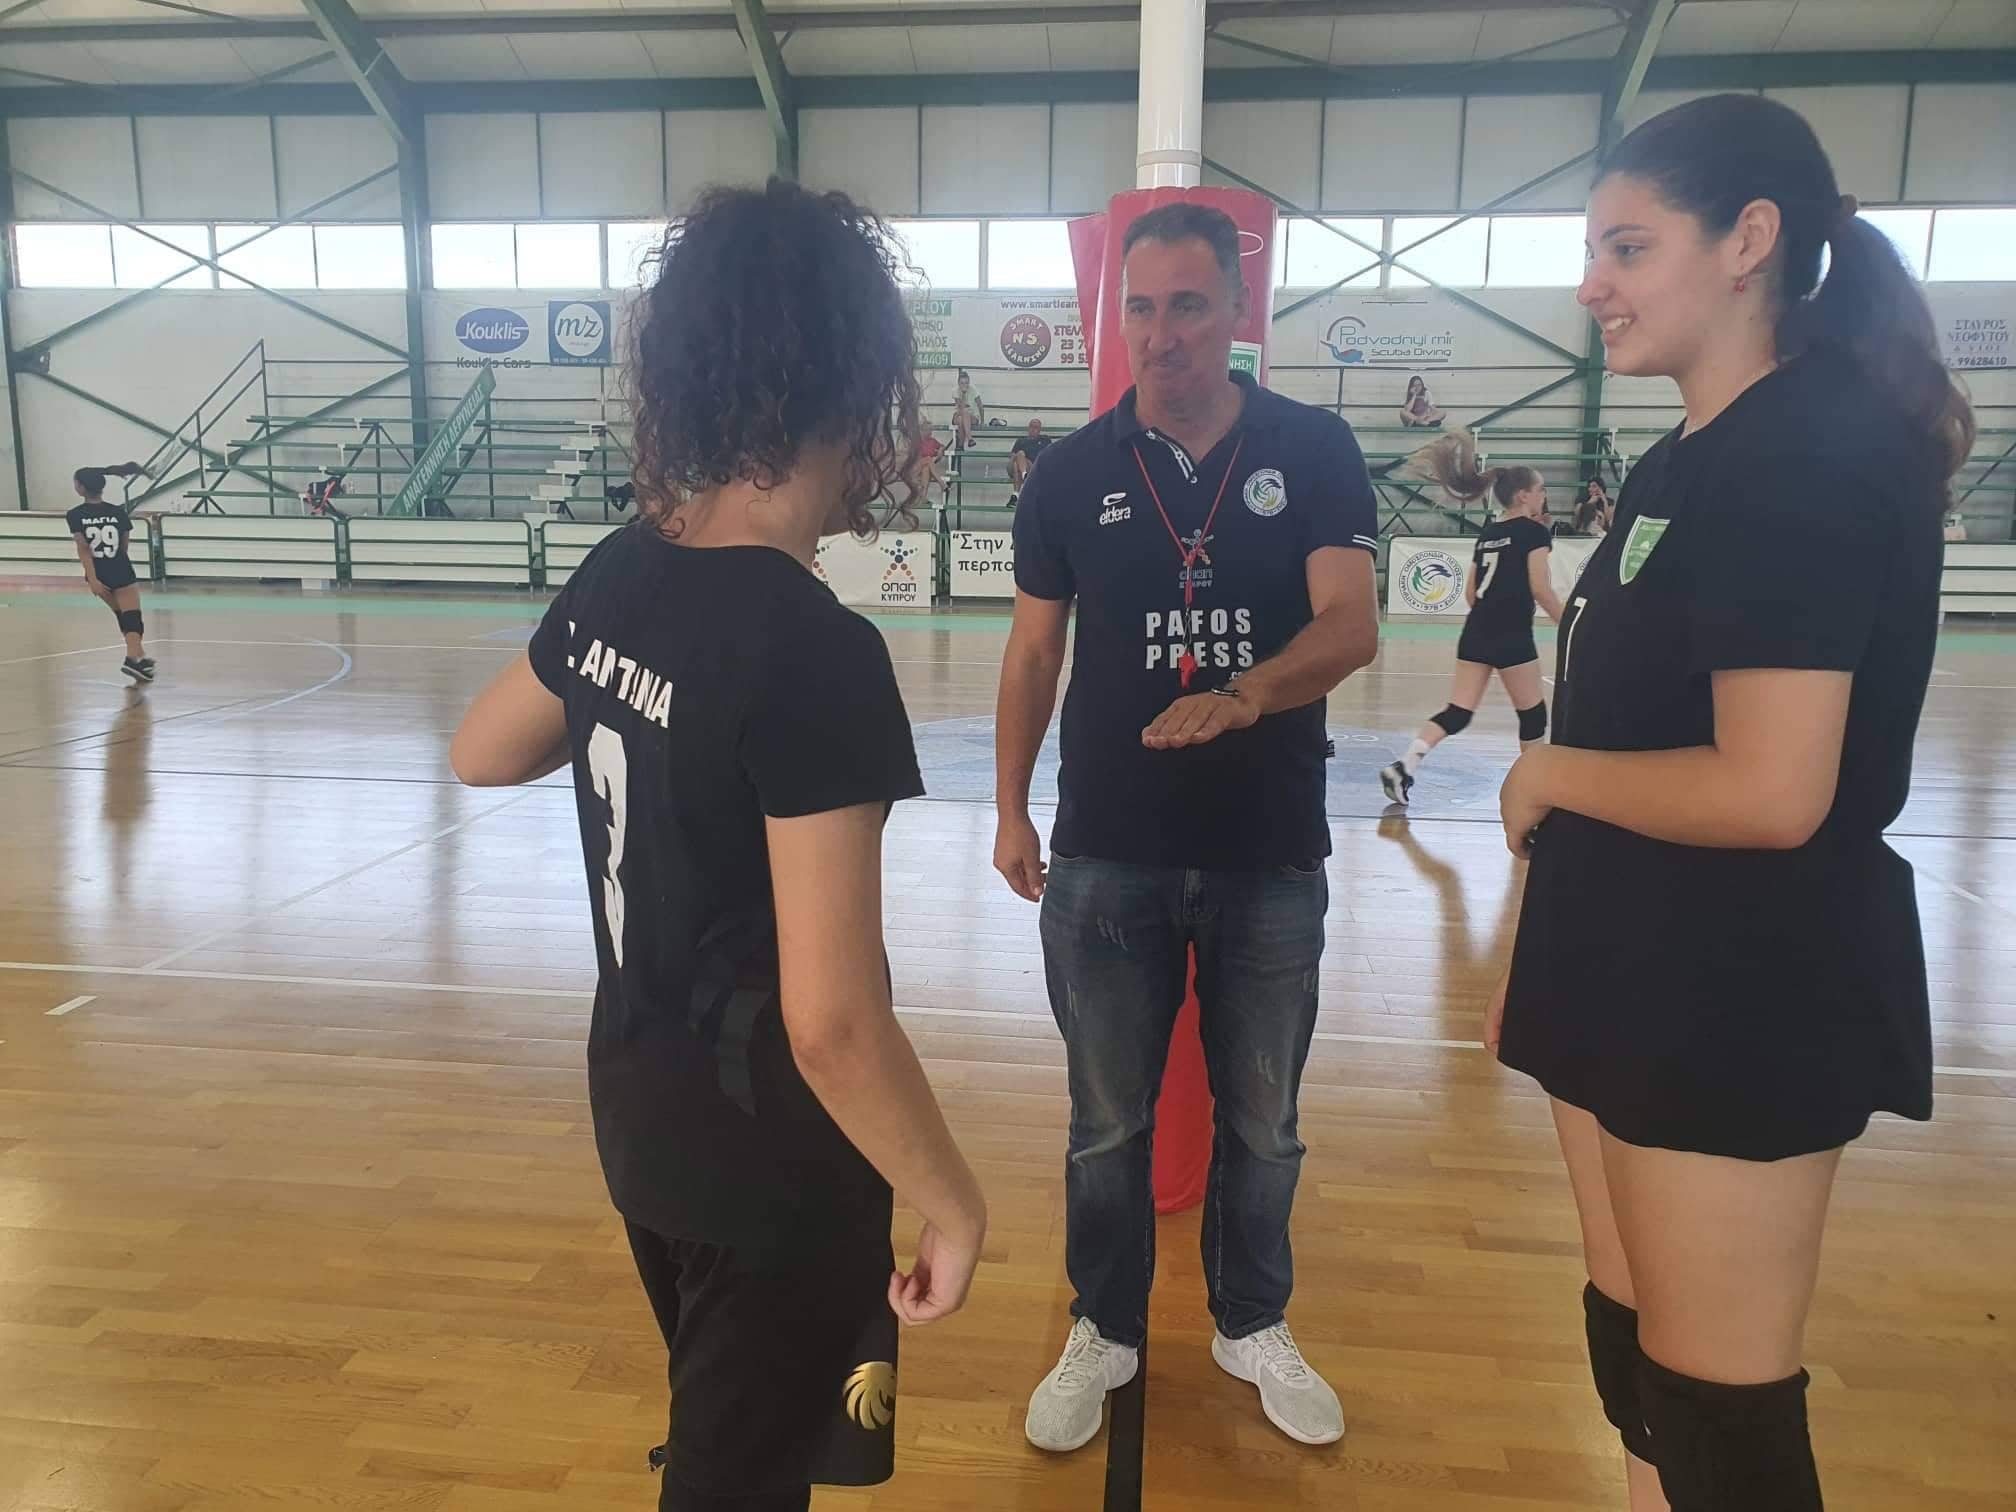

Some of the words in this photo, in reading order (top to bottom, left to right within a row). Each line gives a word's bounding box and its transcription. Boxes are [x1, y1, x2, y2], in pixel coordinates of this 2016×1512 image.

[458, 322, 529, 340] Kouklis
[557, 315, 602, 338] mz
[1060, 339, 1074, 350] 23
[1371, 348, 1411, 357] Scuba
[1413, 348, 1451, 357] Diving
[503, 356, 531, 369] Cars
[1060, 353, 1074, 364] 99
[1099, 505, 1131, 525] eldera
[85, 525, 119, 558] 29
[1476, 551, 1500, 599] 7
[881, 593, 916, 602] ΚΥΠΡΟΥ
[1145, 608, 1252, 638] PAFOS
[1145, 641, 1254, 670] PRESS
